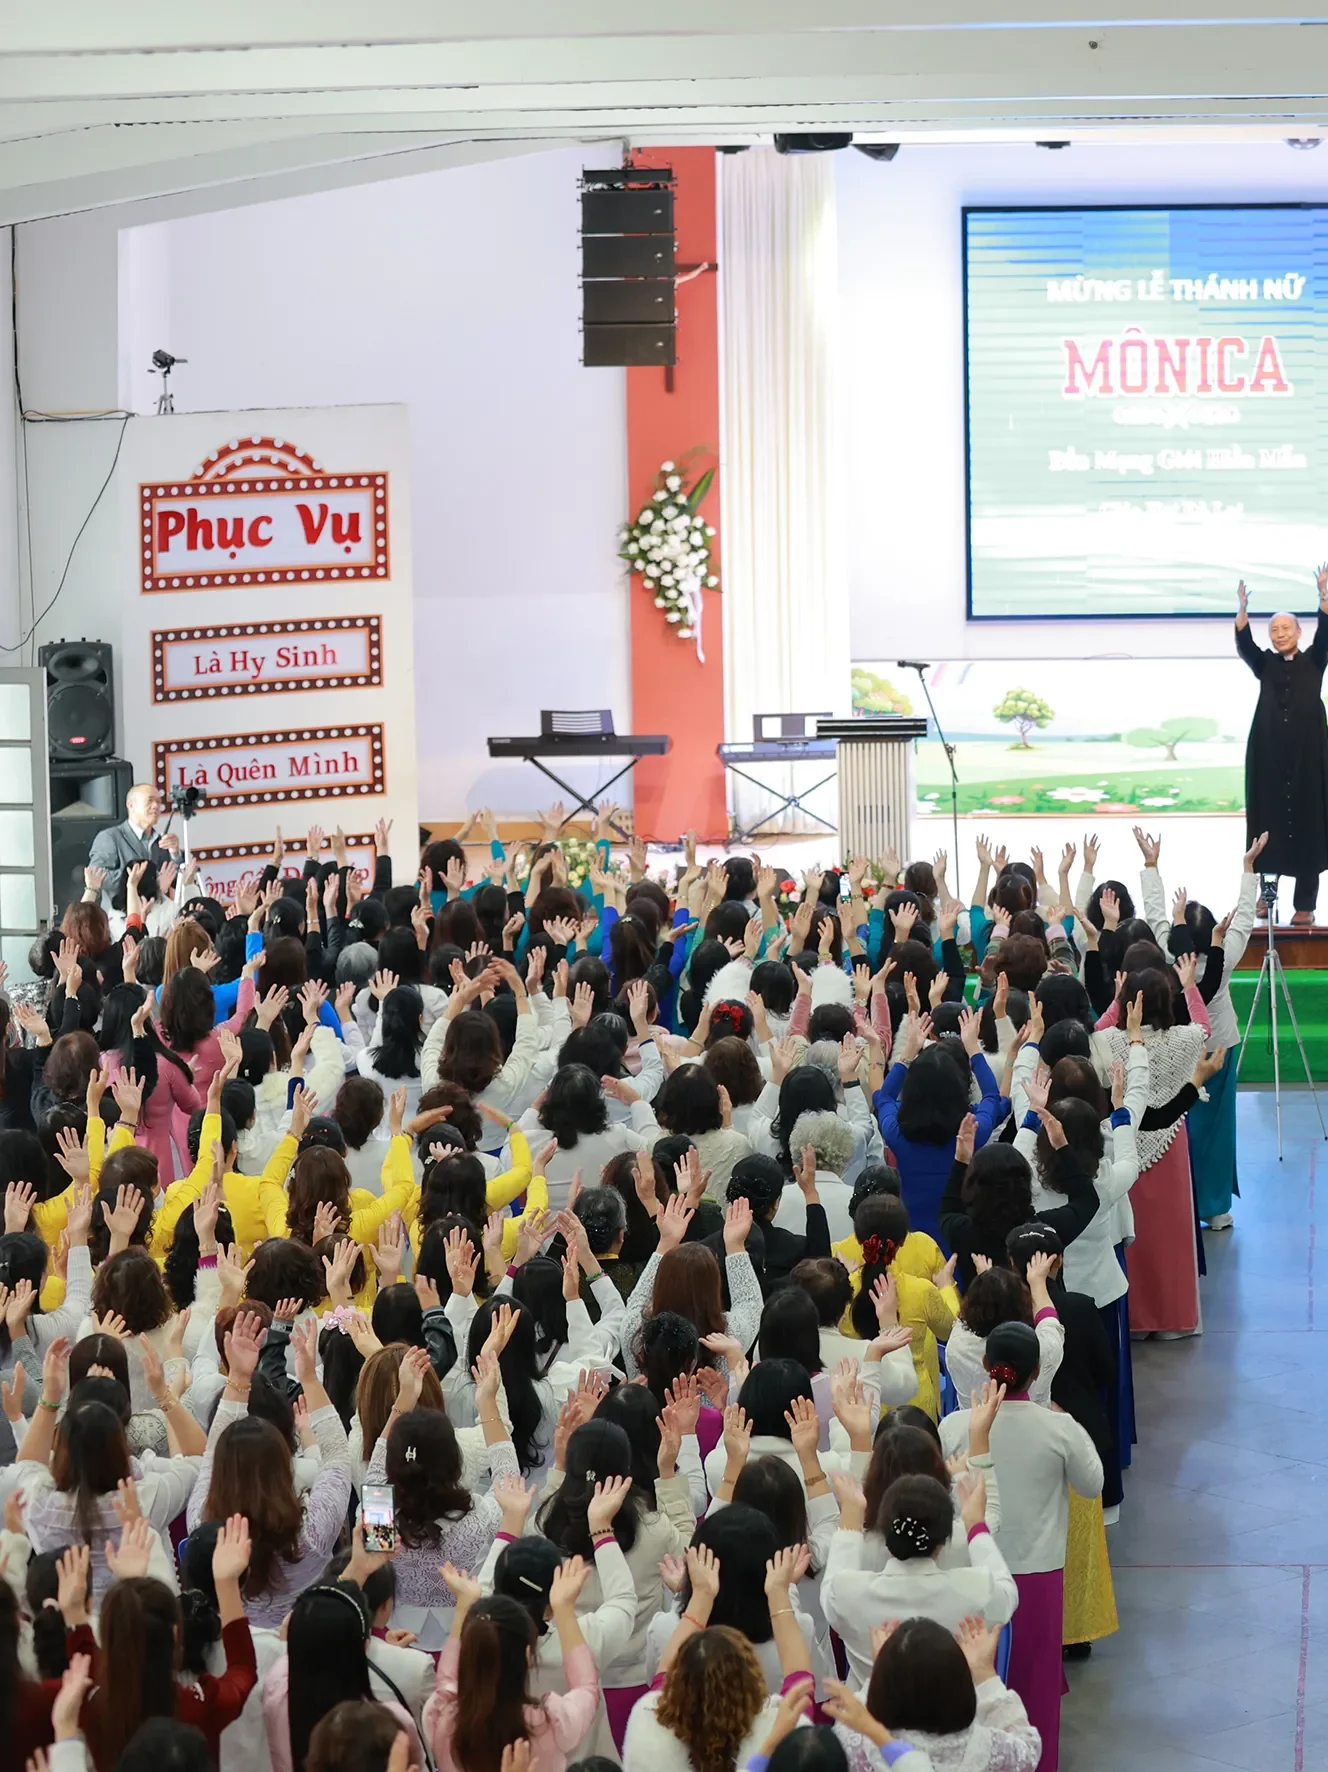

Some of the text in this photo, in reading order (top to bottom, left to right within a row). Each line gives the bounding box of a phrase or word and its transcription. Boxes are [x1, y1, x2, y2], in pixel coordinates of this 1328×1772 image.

[1137, 269, 1166, 301] LỄ
[1169, 273, 1258, 301] THÁNH
[1263, 272, 1306, 301] NỮ
[1062, 325, 1291, 395] MÔNICA
[157, 503, 362, 560] Phục Vụ
[193, 643, 339, 680] Là Hy Sinh
[177, 751, 360, 789] Là Quên Mình
